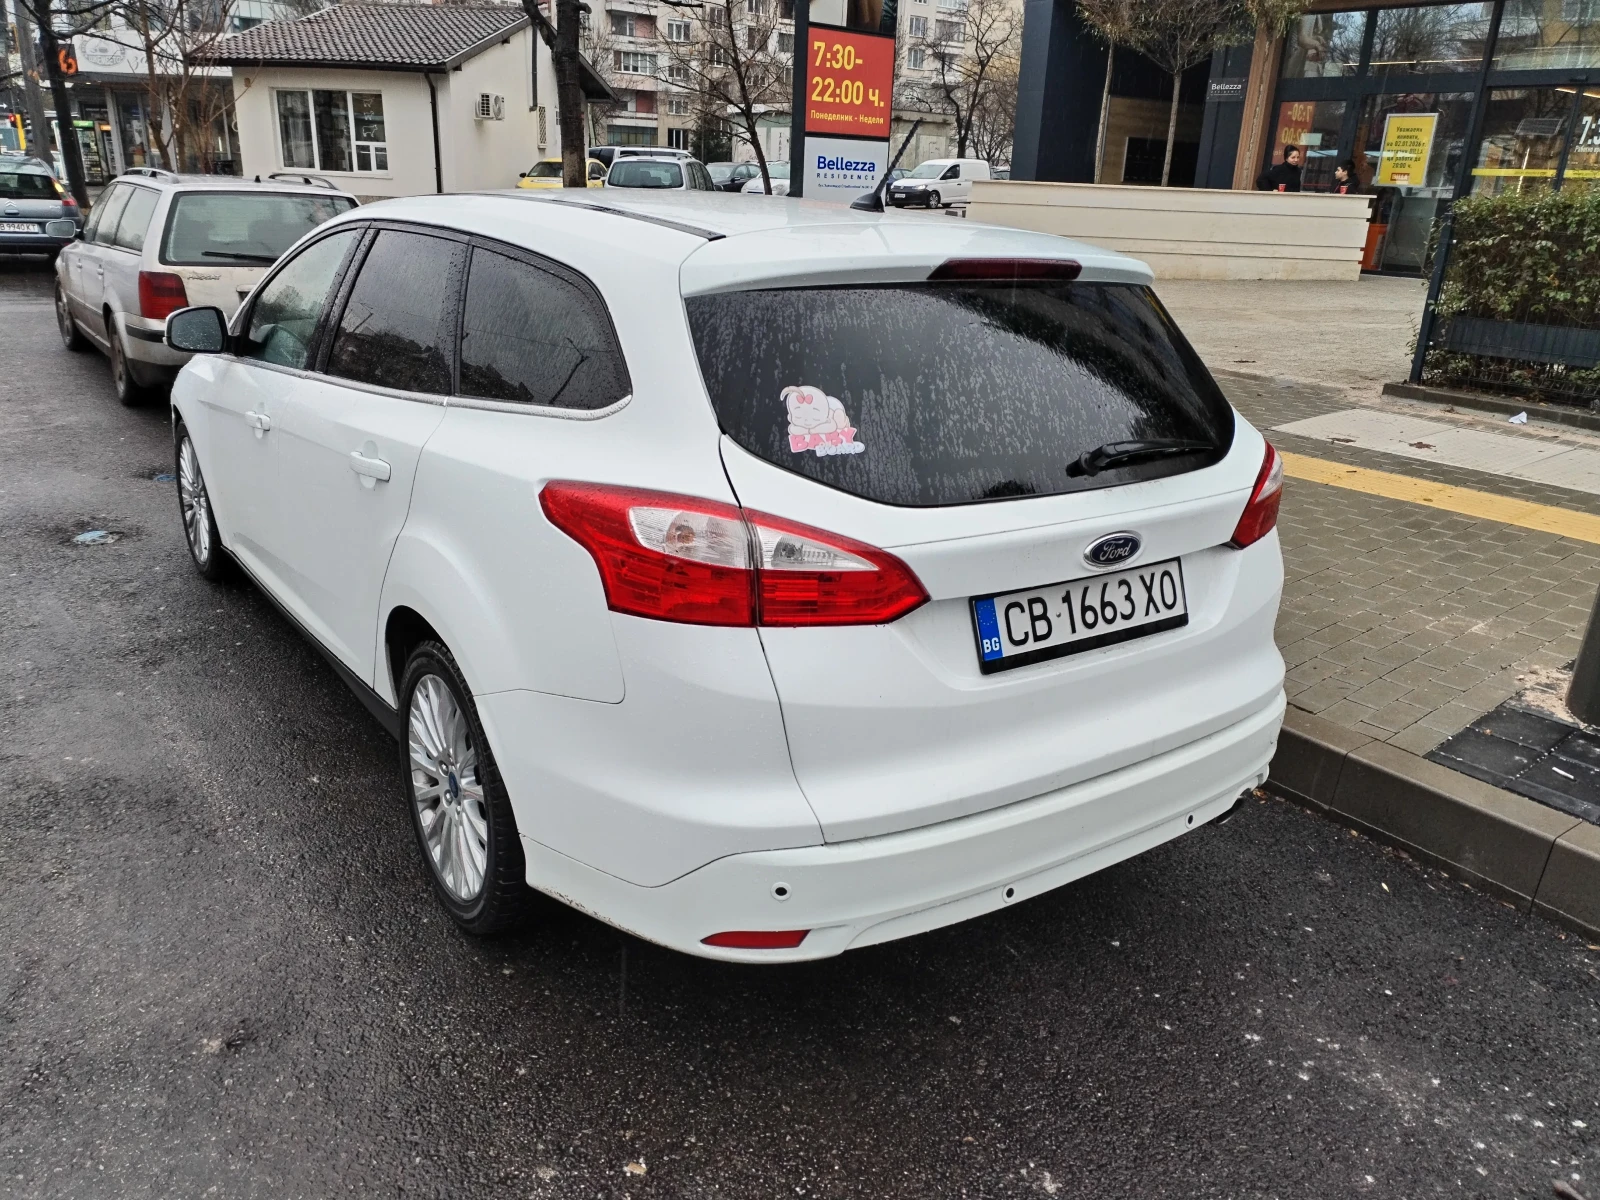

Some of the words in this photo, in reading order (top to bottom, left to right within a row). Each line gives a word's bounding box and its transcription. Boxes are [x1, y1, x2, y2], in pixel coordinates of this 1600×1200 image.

[813, 41, 863, 70] 7:30-
[811, 76, 863, 105] 22:00
[868, 88, 884, 107] ч.
[810, 109, 853, 121] Понеделник
[859, 113, 884, 124] Неделя
[817, 155, 875, 172] Bellezza
[790, 428, 855, 452] BABY
[1100, 539, 1132, 560] Ford
[1004, 596, 1053, 647] CB
[1061, 579, 1136, 635] 1663
[1139, 569, 1178, 616] XO
[983, 637, 1000, 653] BG
